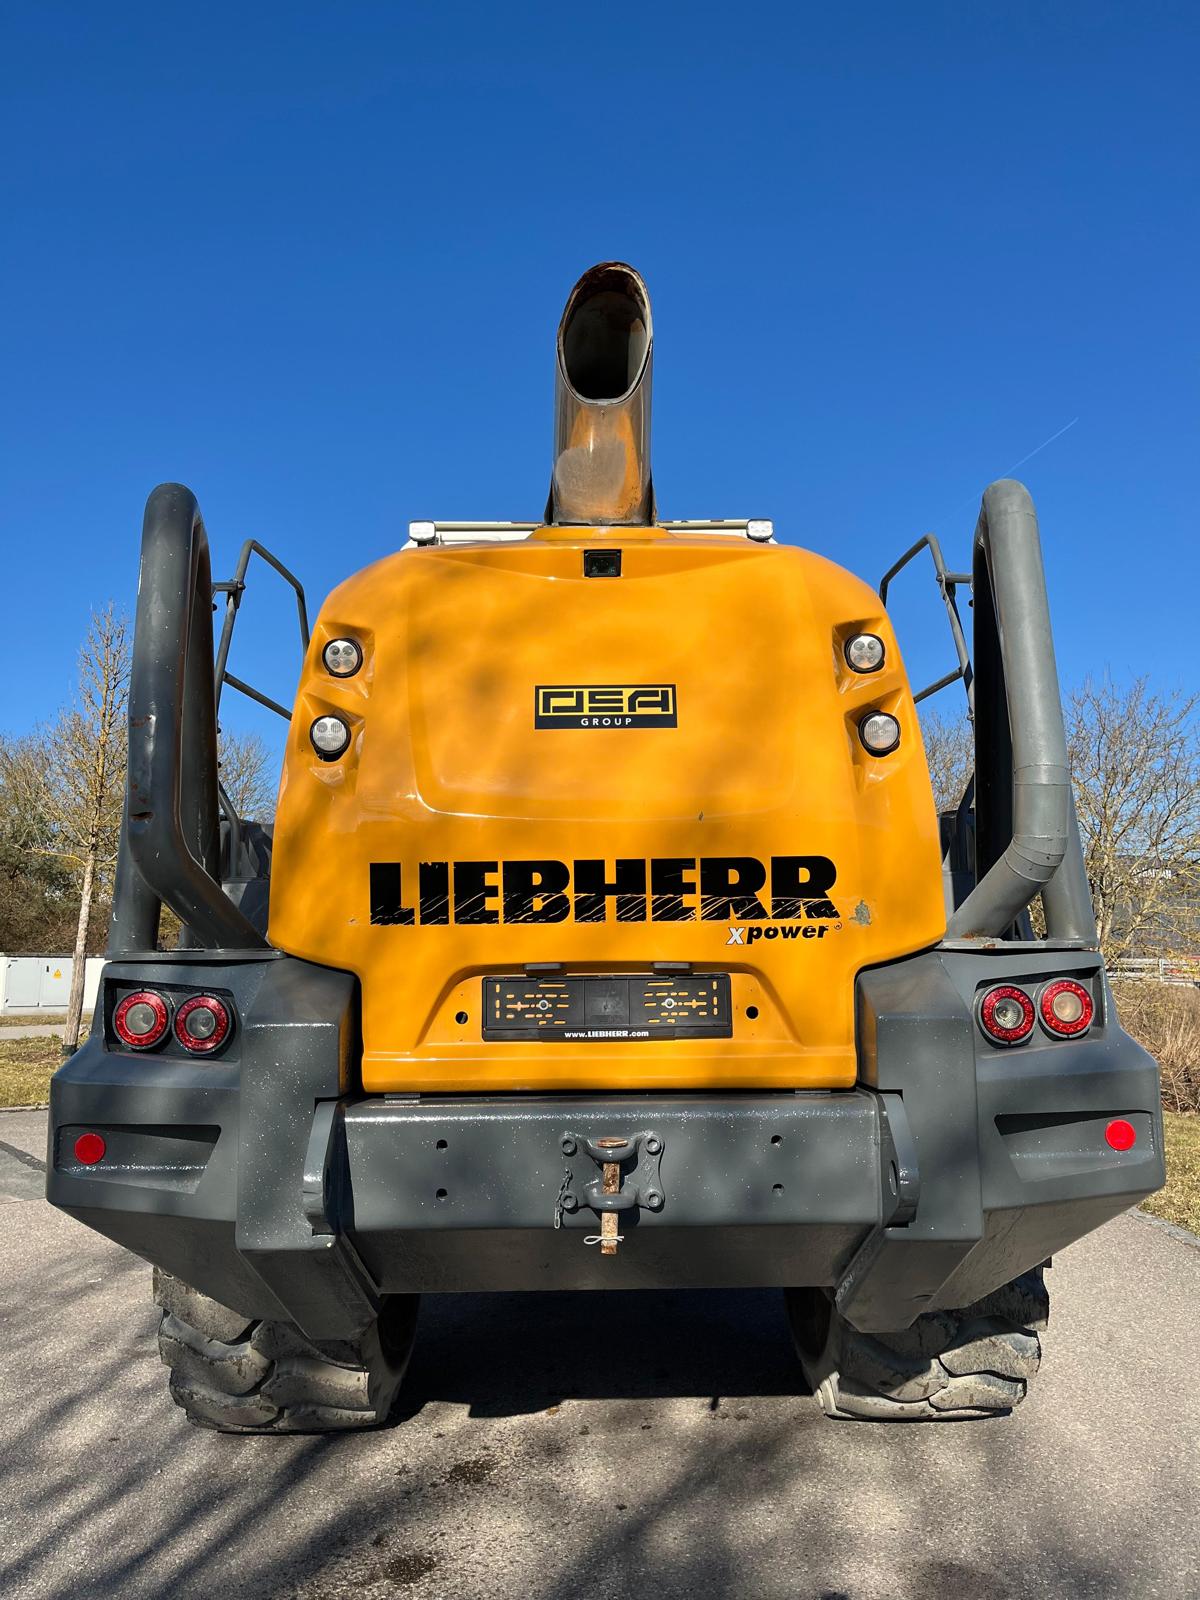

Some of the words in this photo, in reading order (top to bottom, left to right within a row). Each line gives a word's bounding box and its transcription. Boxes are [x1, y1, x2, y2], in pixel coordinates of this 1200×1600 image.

[580, 717, 633, 726] GROUP
[369, 855, 842, 926] LIEBHERR
[564, 1030, 649, 1039] www.LIEBHERR.com
